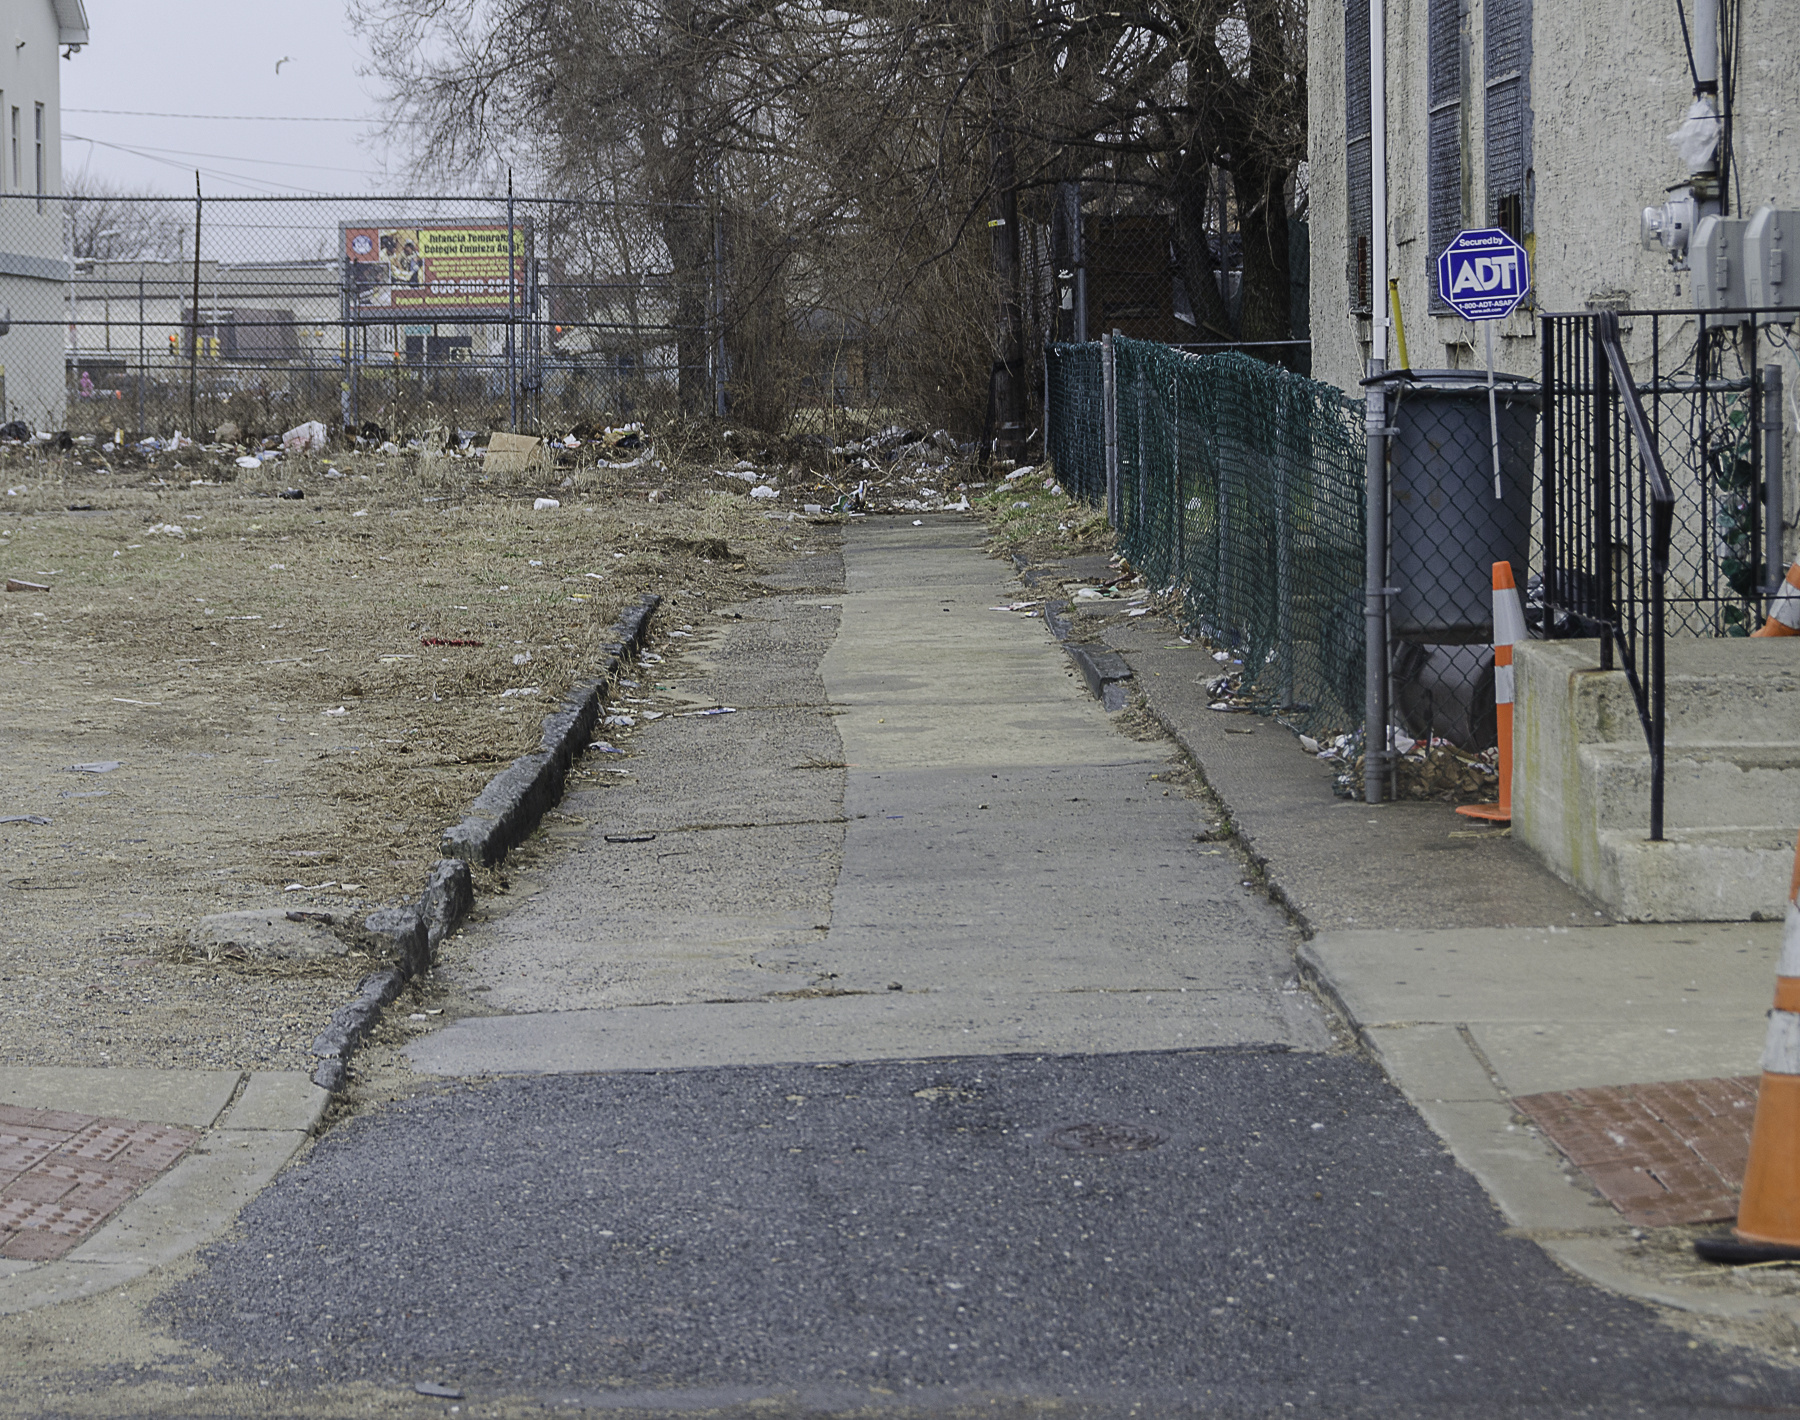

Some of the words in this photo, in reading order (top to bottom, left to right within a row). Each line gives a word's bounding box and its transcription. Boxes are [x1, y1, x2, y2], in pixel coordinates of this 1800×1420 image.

[1459, 238, 1492, 247] Secured
[1493, 237, 1503, 245] by
[1452, 256, 1516, 294] ADT
[1458, 300, 1513, 310] 1-800-ADT-ASAP
